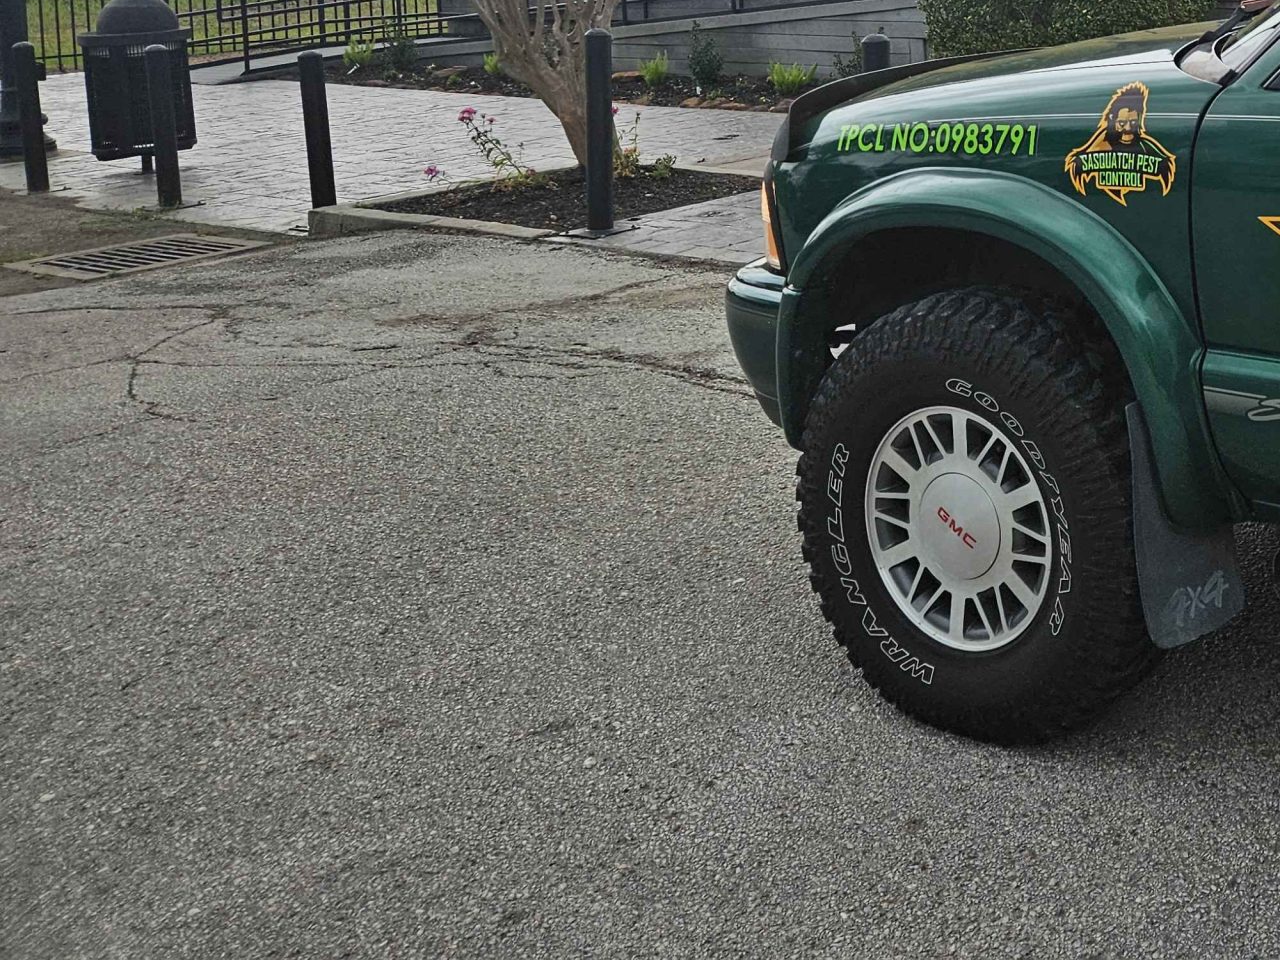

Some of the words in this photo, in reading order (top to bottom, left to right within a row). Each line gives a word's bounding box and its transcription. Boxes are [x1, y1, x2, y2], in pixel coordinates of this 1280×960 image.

[836, 124, 884, 152] TPCL
[890, 123, 1037, 156] NO:0983791
[1080, 152, 1135, 171] SASQUATCH
[1137, 154, 1163, 174] PEST
[1100, 171, 1142, 187] CONTROL
[945, 378, 1072, 636] GOODYEAR
[937, 506, 977, 550] GMC
[827, 442, 935, 685] WRANGLER
